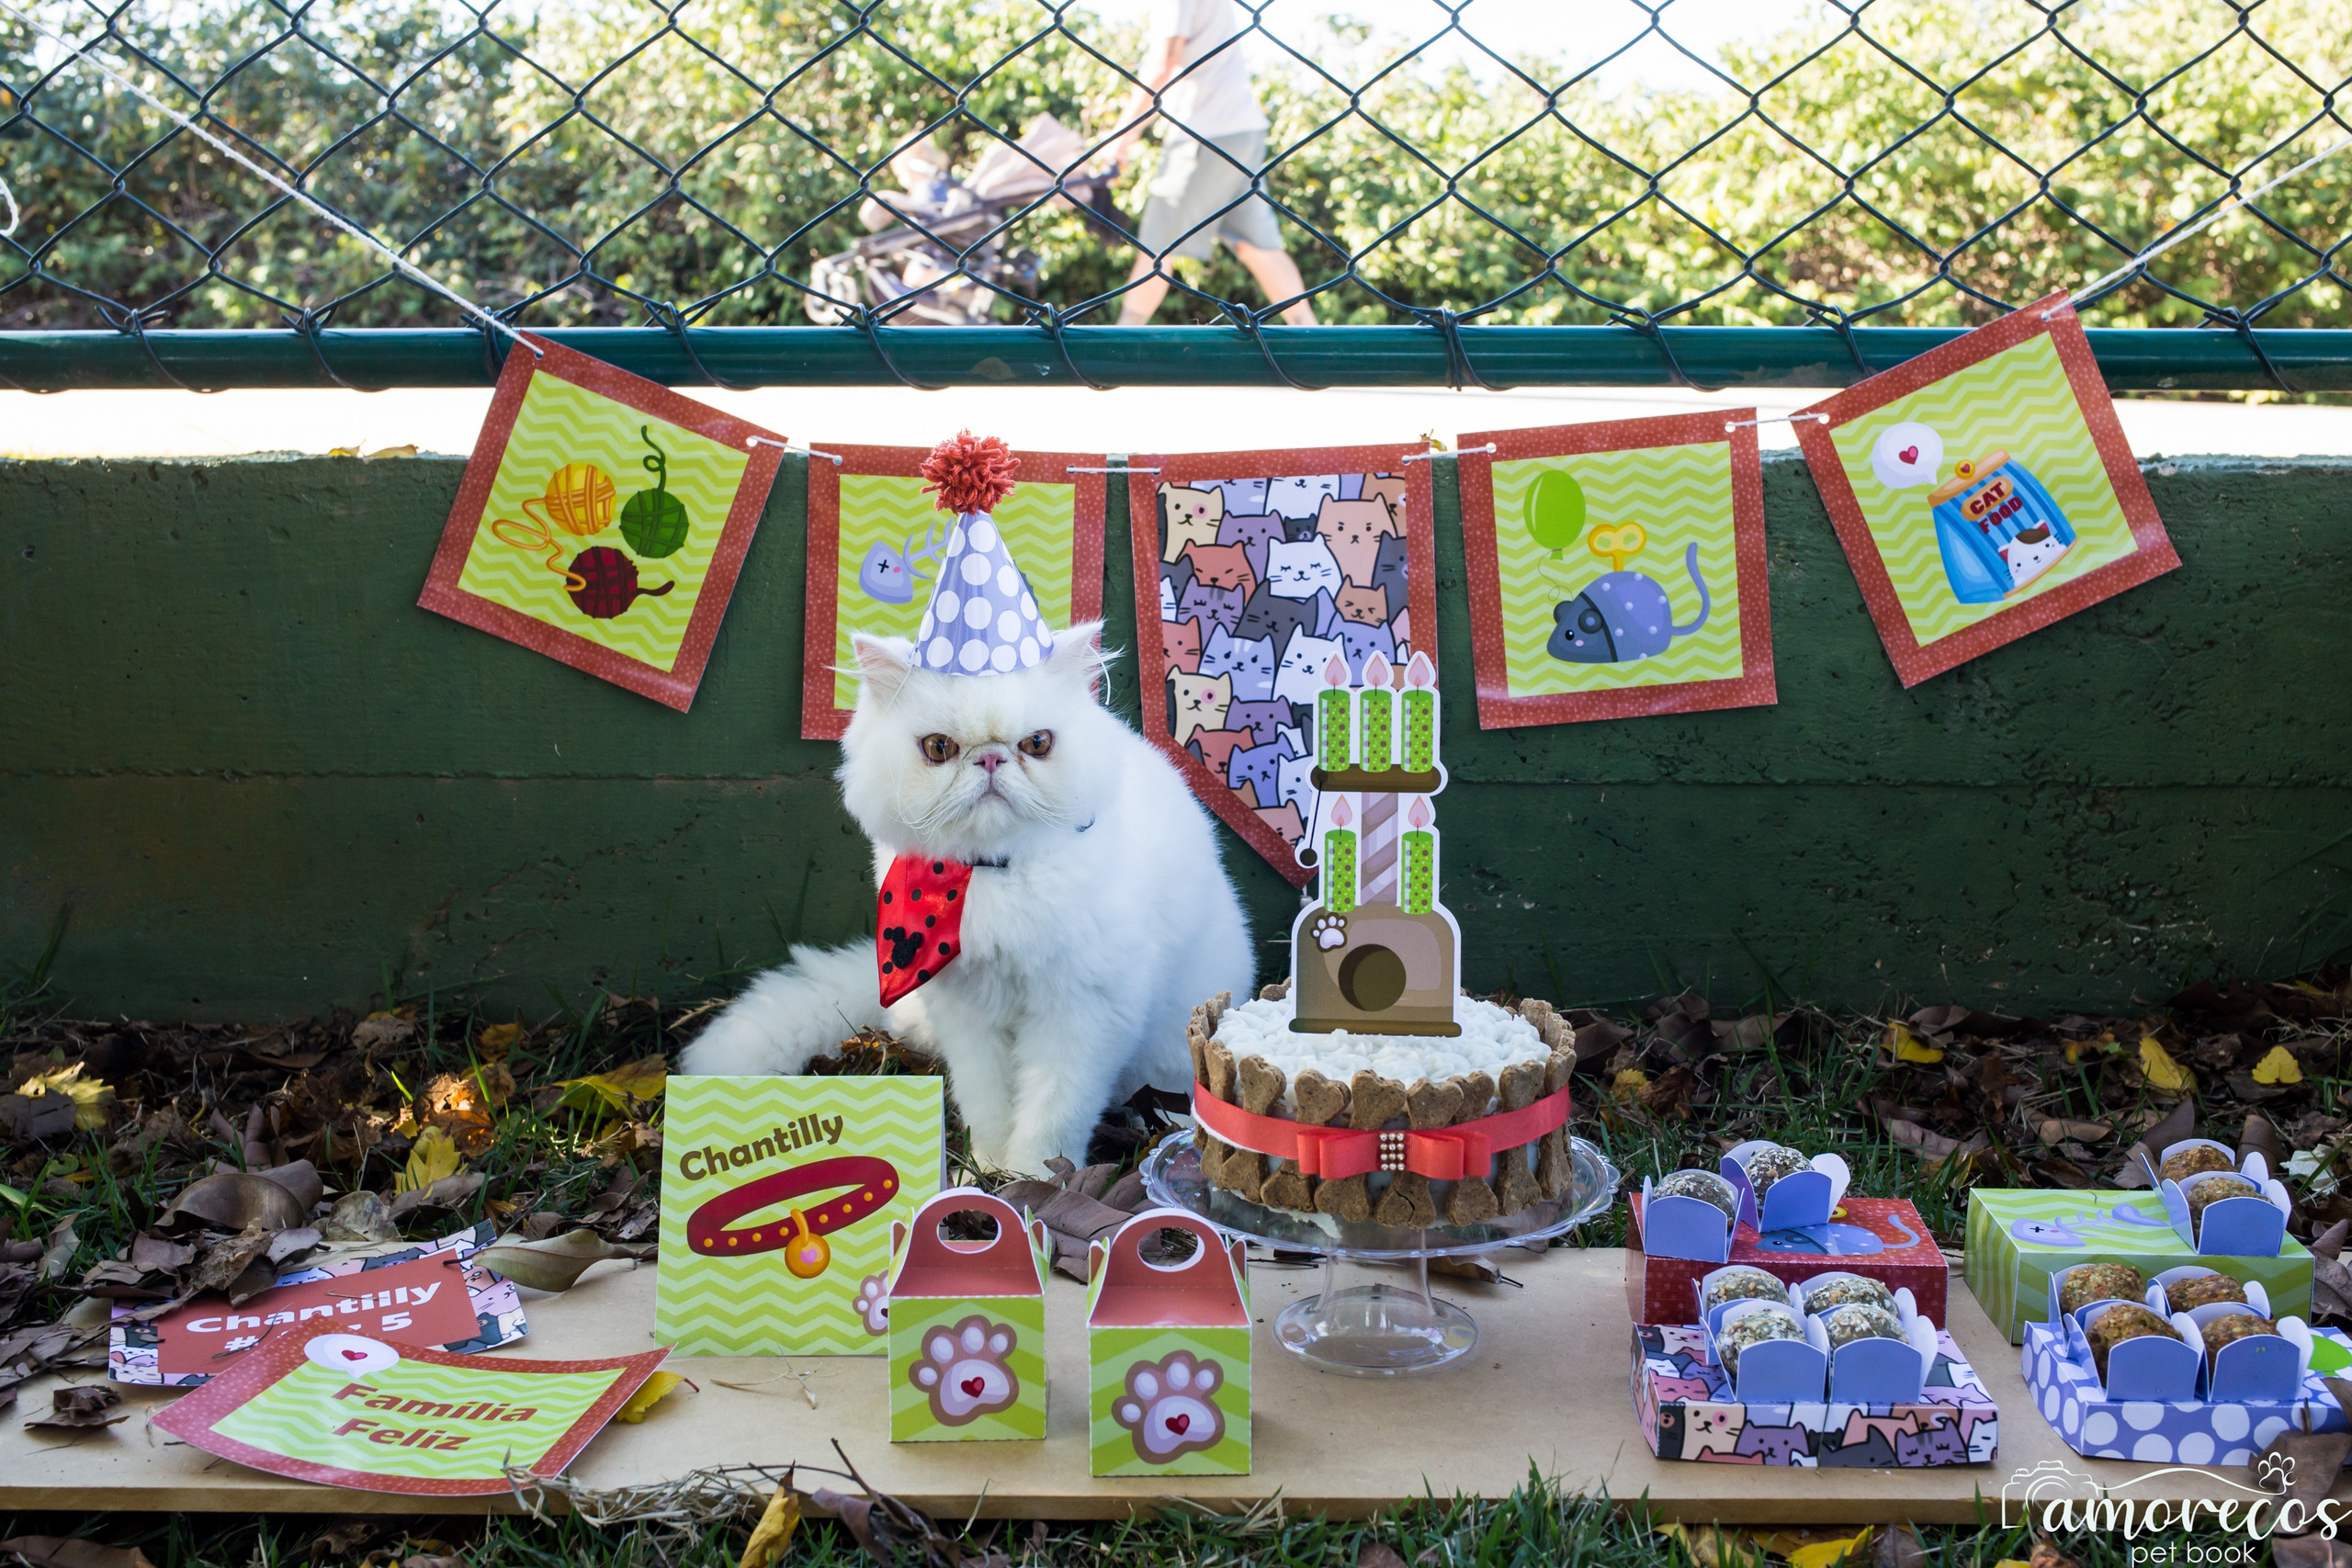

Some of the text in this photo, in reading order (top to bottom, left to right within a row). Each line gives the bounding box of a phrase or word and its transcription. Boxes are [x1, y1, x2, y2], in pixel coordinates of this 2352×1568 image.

[1970, 481, 2006, 515] CAT
[1978, 496, 2023, 535] FOOD
[679, 1112, 843, 1181] Chantilly
[186, 1281, 442, 1333] Chantilly
[382, 1311, 413, 1332] 5
[332, 1417, 471, 1451] Feliz
